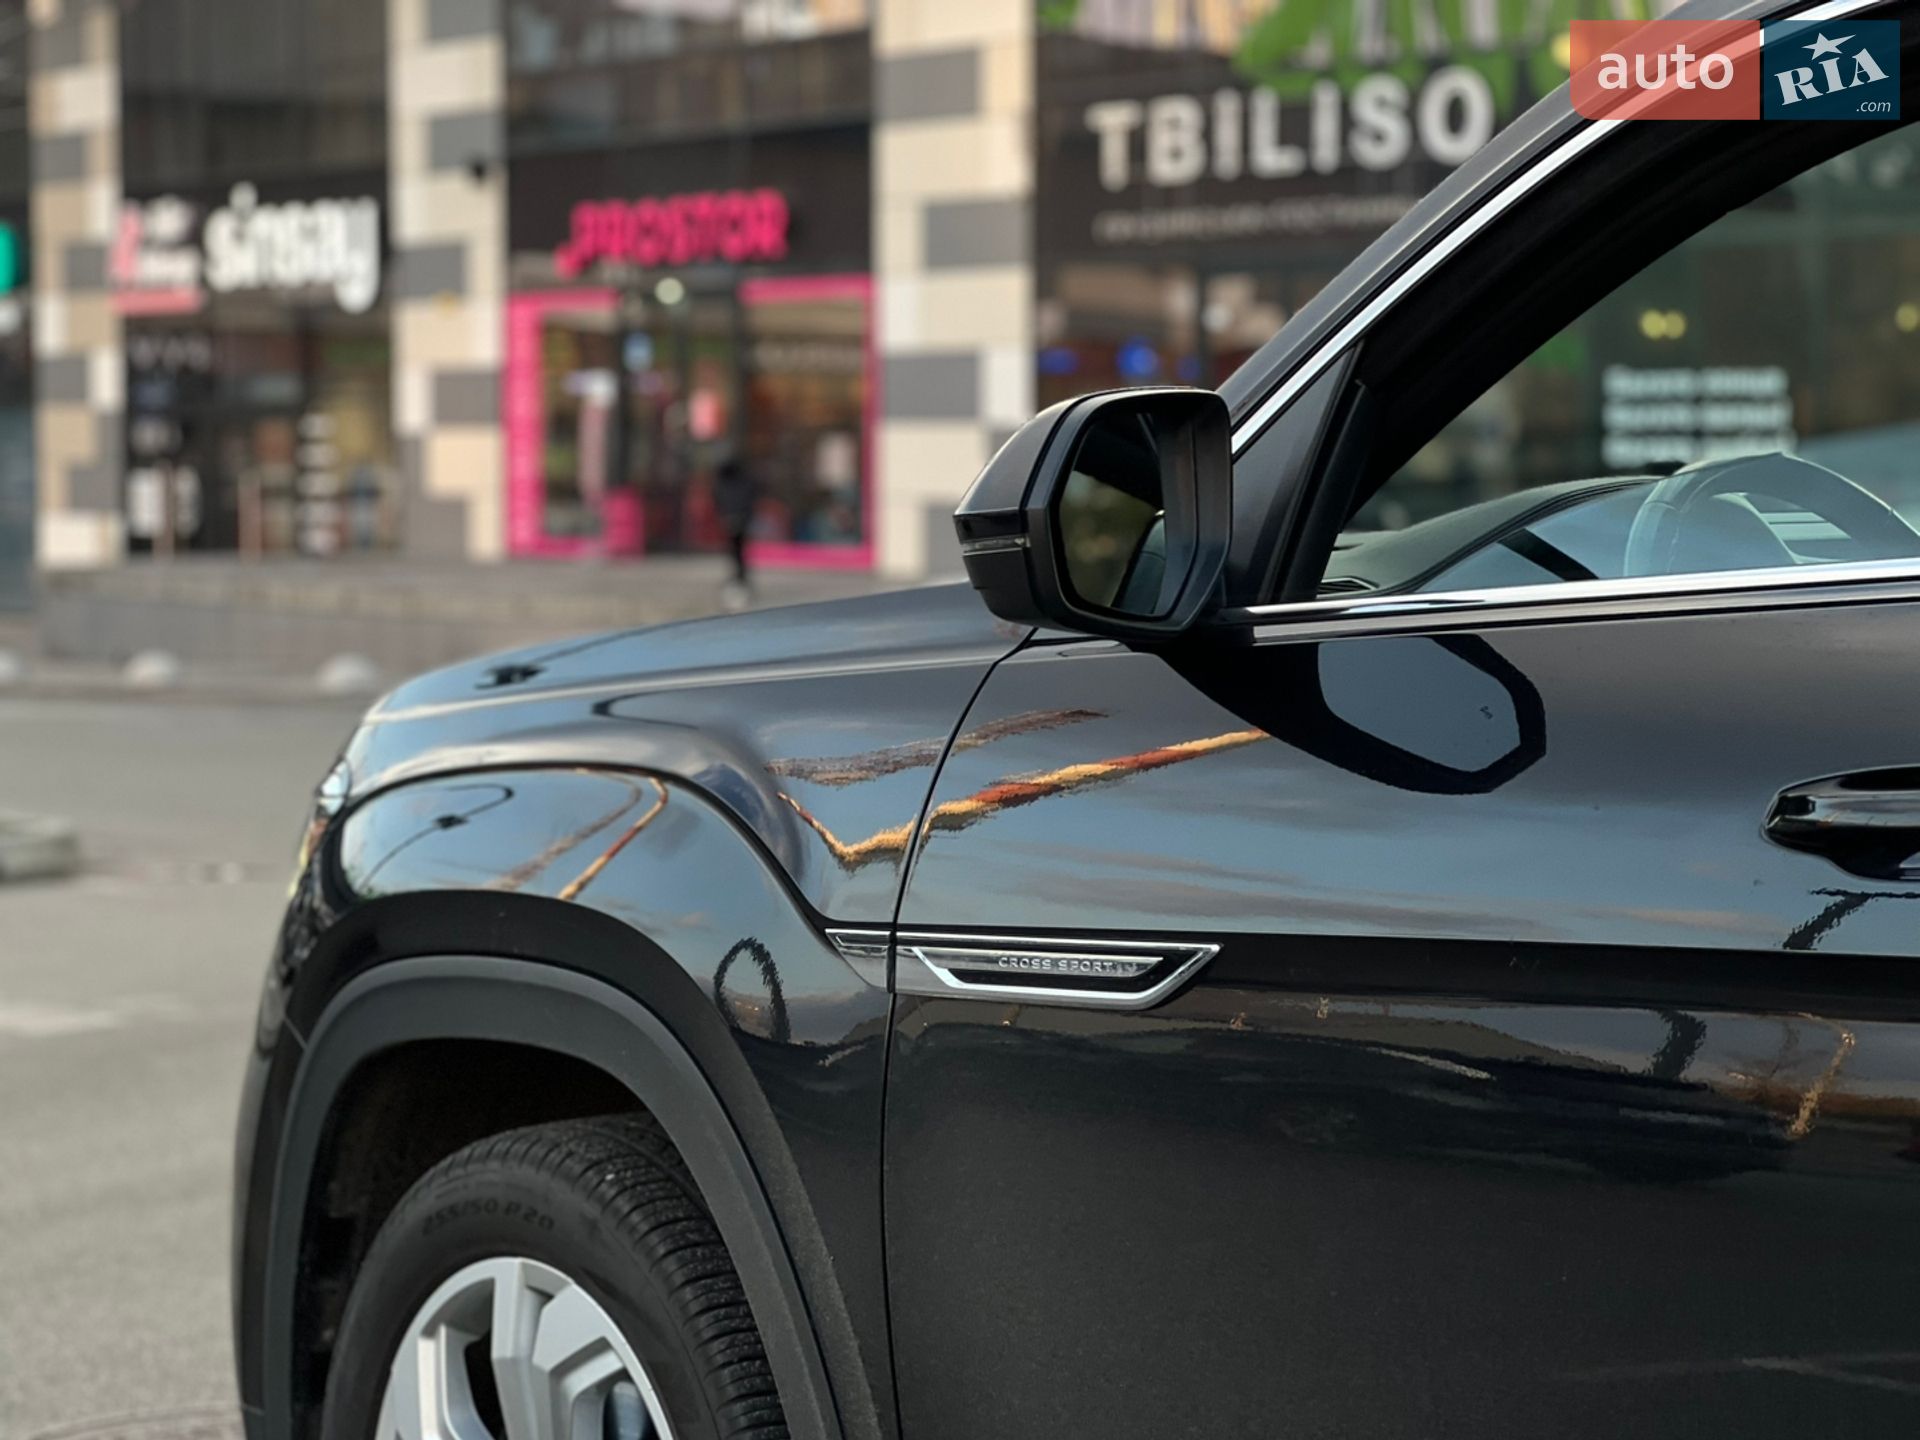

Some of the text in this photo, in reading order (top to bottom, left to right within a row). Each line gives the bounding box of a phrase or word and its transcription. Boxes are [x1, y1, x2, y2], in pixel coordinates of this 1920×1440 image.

[1085, 66, 1496, 192] TBILISO
[204, 181, 382, 313] sinsay
[998, 956, 1113, 973] CROSS SPORT
